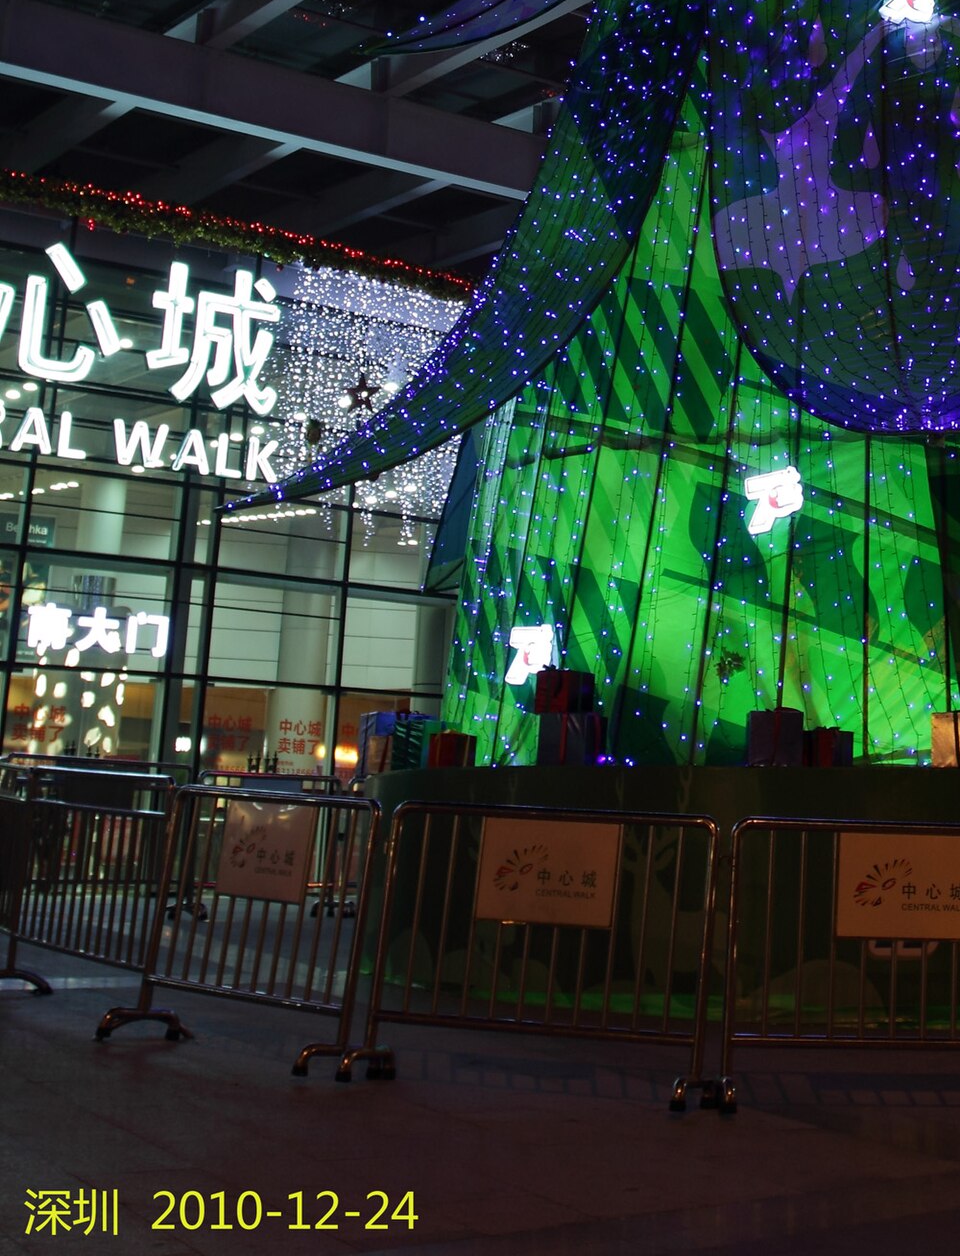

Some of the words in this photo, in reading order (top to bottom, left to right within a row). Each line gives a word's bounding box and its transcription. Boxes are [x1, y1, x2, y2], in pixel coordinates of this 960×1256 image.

[0, 242, 281, 417] 心城
[0, 399, 87, 460] AL
[113, 417, 279, 484] WALK
[279, 719, 321, 736] 中心城
[537, 868, 597, 888] 中心城
[901, 903, 941, 912] CENTRAL
